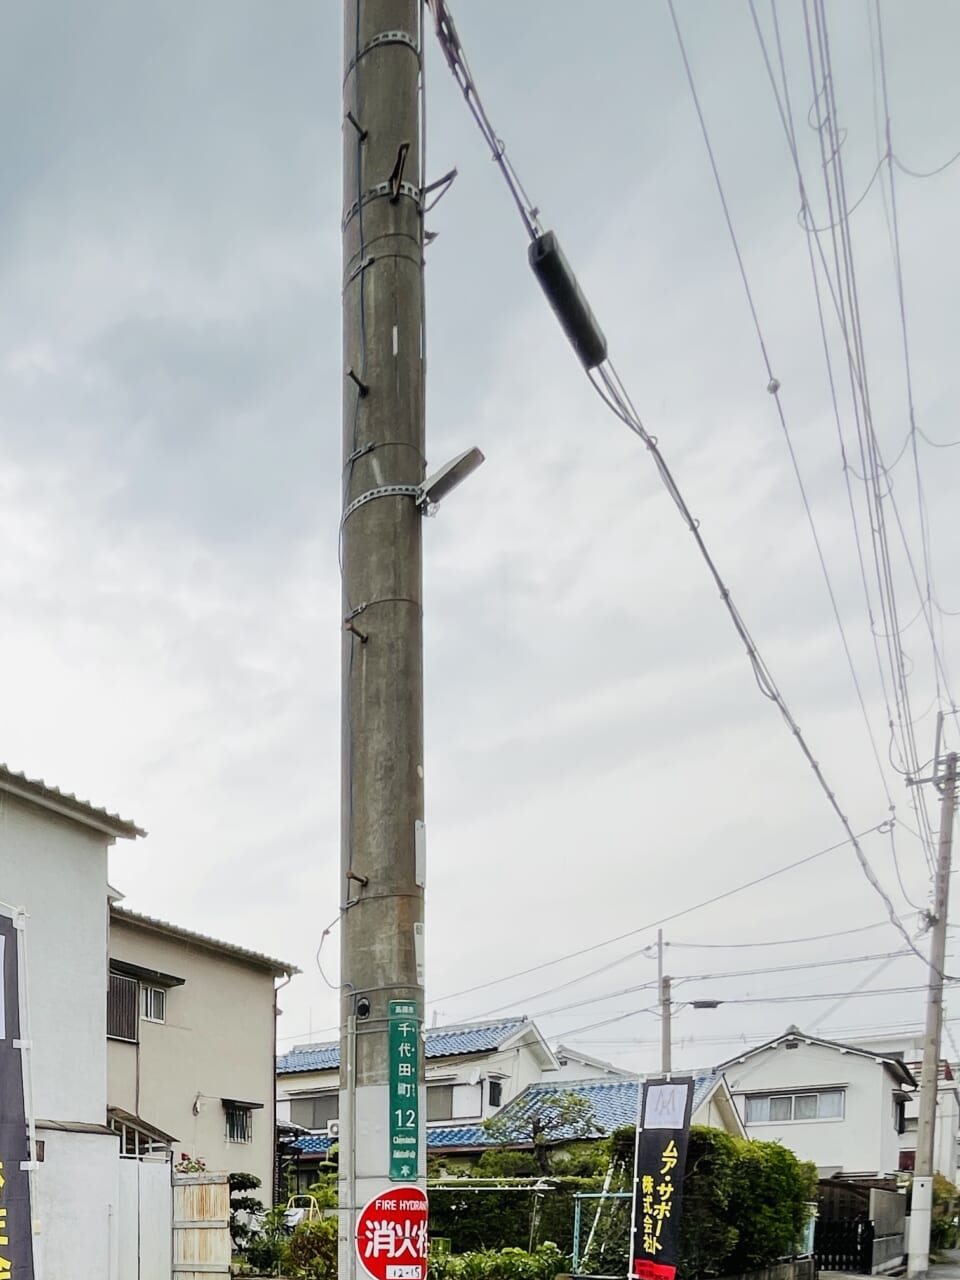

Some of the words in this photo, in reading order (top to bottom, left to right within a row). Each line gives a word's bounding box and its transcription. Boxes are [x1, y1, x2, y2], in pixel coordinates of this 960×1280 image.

[397, 1022, 412, 1098] 千代田町
[395, 1109, 415, 1127] 12
[375, 1199, 397, 1211] FIRE
[399, 1199, 428, 1211] HYDRAN
[642, 1175, 655, 1253] 株式会社
